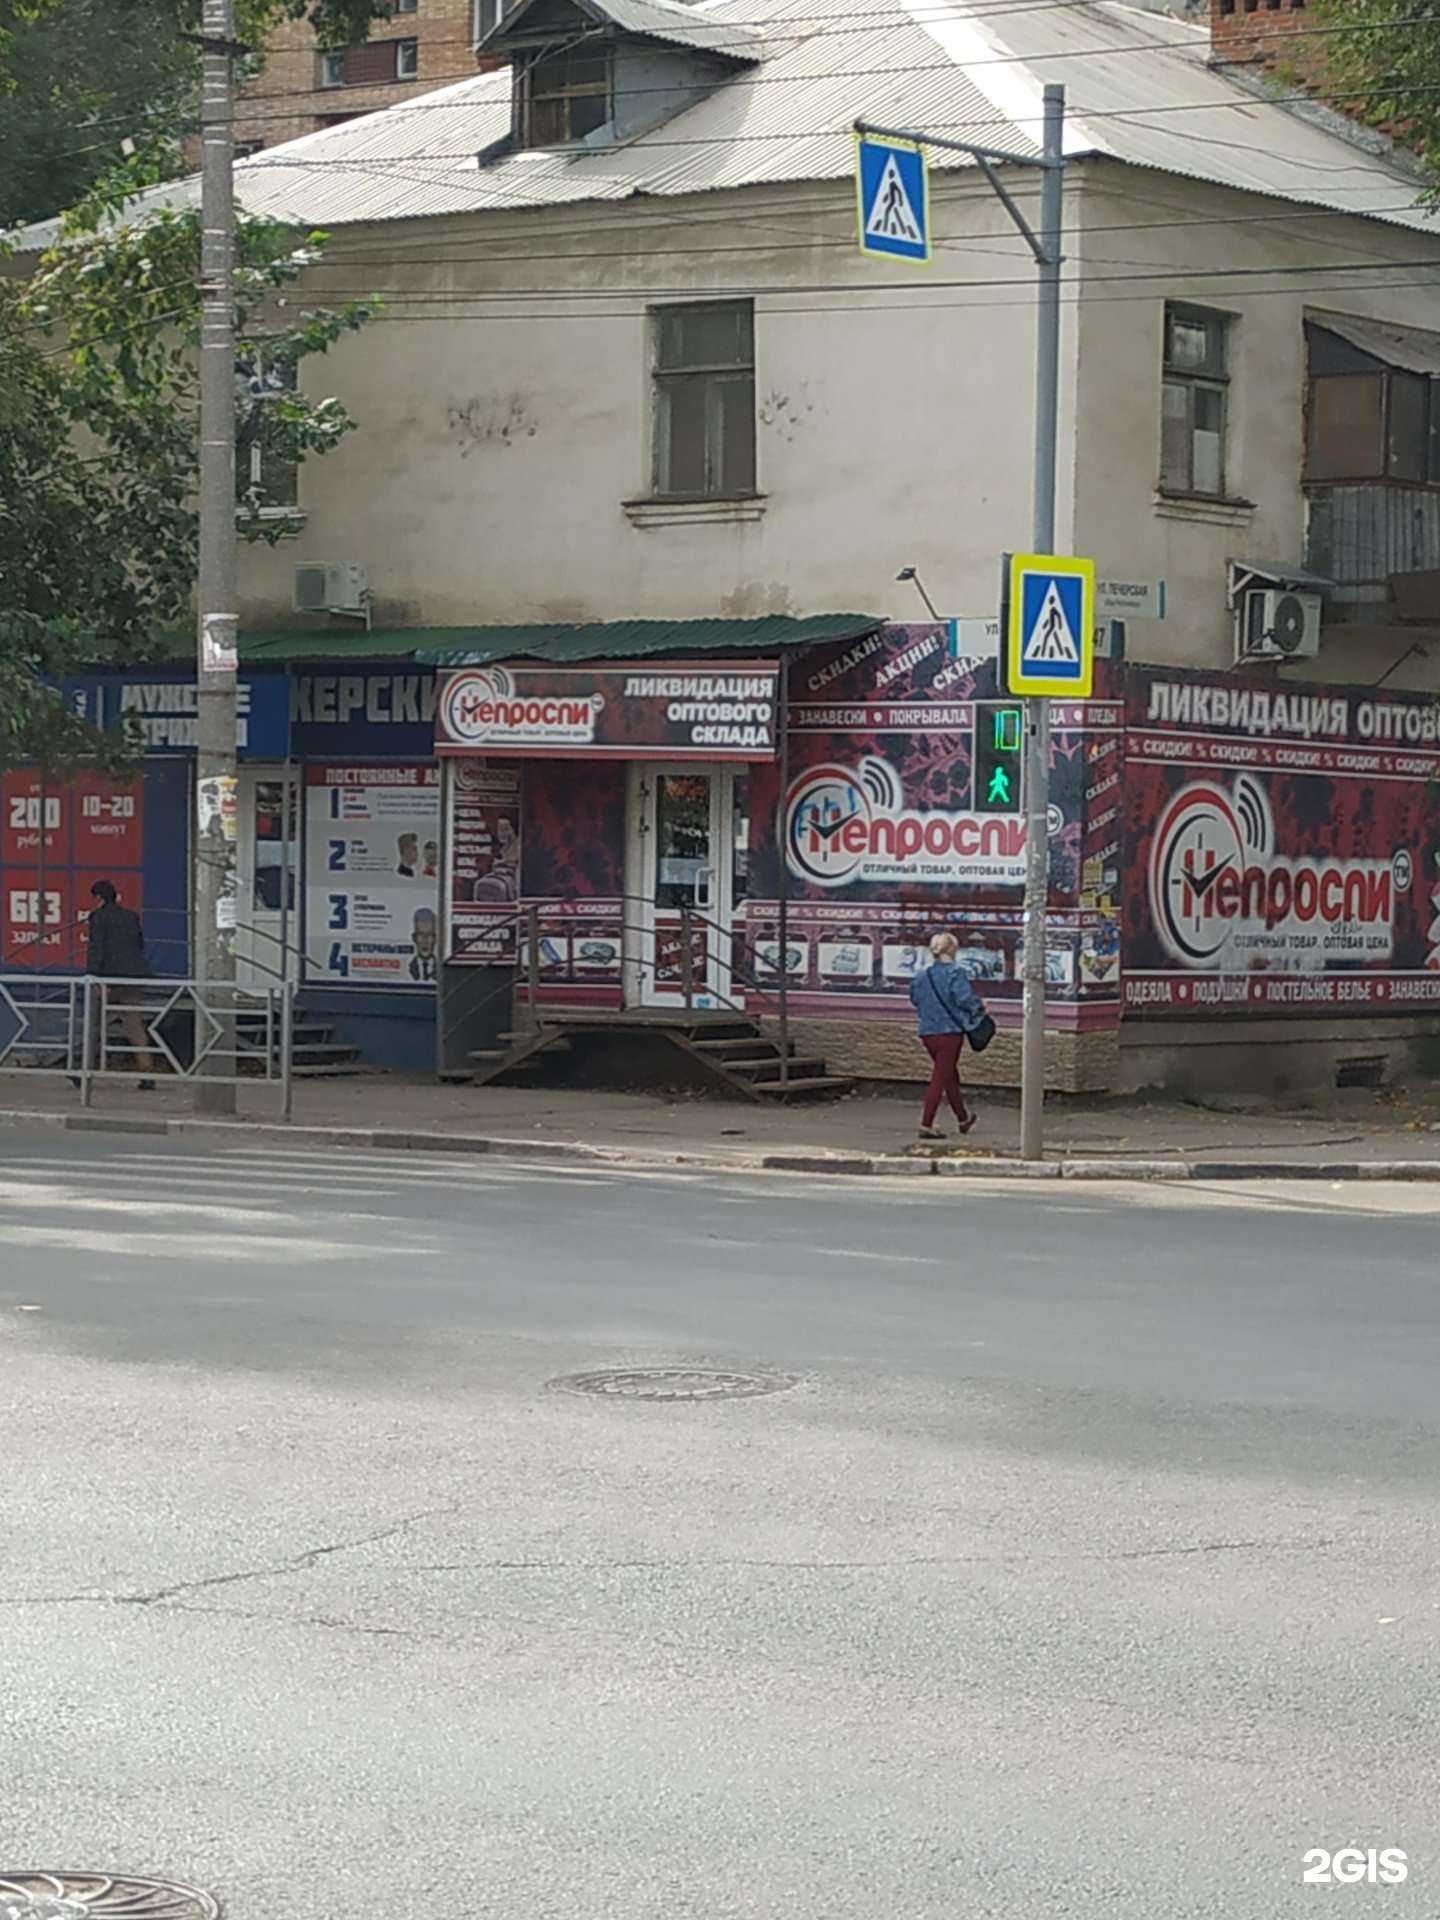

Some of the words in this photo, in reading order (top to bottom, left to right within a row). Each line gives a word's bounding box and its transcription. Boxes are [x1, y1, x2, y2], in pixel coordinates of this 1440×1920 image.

[874, 635, 941, 688] АКЦИИ!
[624, 677, 775, 700] ЛИКВИДАЦИЯ
[667, 702, 771, 723] ОПТОВОГО
[888, 708, 968, 725] ПОКРЫВАЛА
[1147, 682, 1348, 738] ЛИКВИДАЦИЯ
[1357, 702, 1440, 741] ОПТОВ
[691, 726, 770, 746] СКЛАДА
[10, 797, 60, 828] 200
[82, 796, 134, 817] 10-20
[329, 840, 346, 871] 2
[329, 894, 347, 930] 3
[329, 942, 348, 976] 4
[1126, 981, 1173, 1005] ОДЕЯЛА
[1192, 980, 1250, 1004] ПОДУШКИ
[1266, 981, 1334, 1001] ПОСТЕЛЬНОЕ
